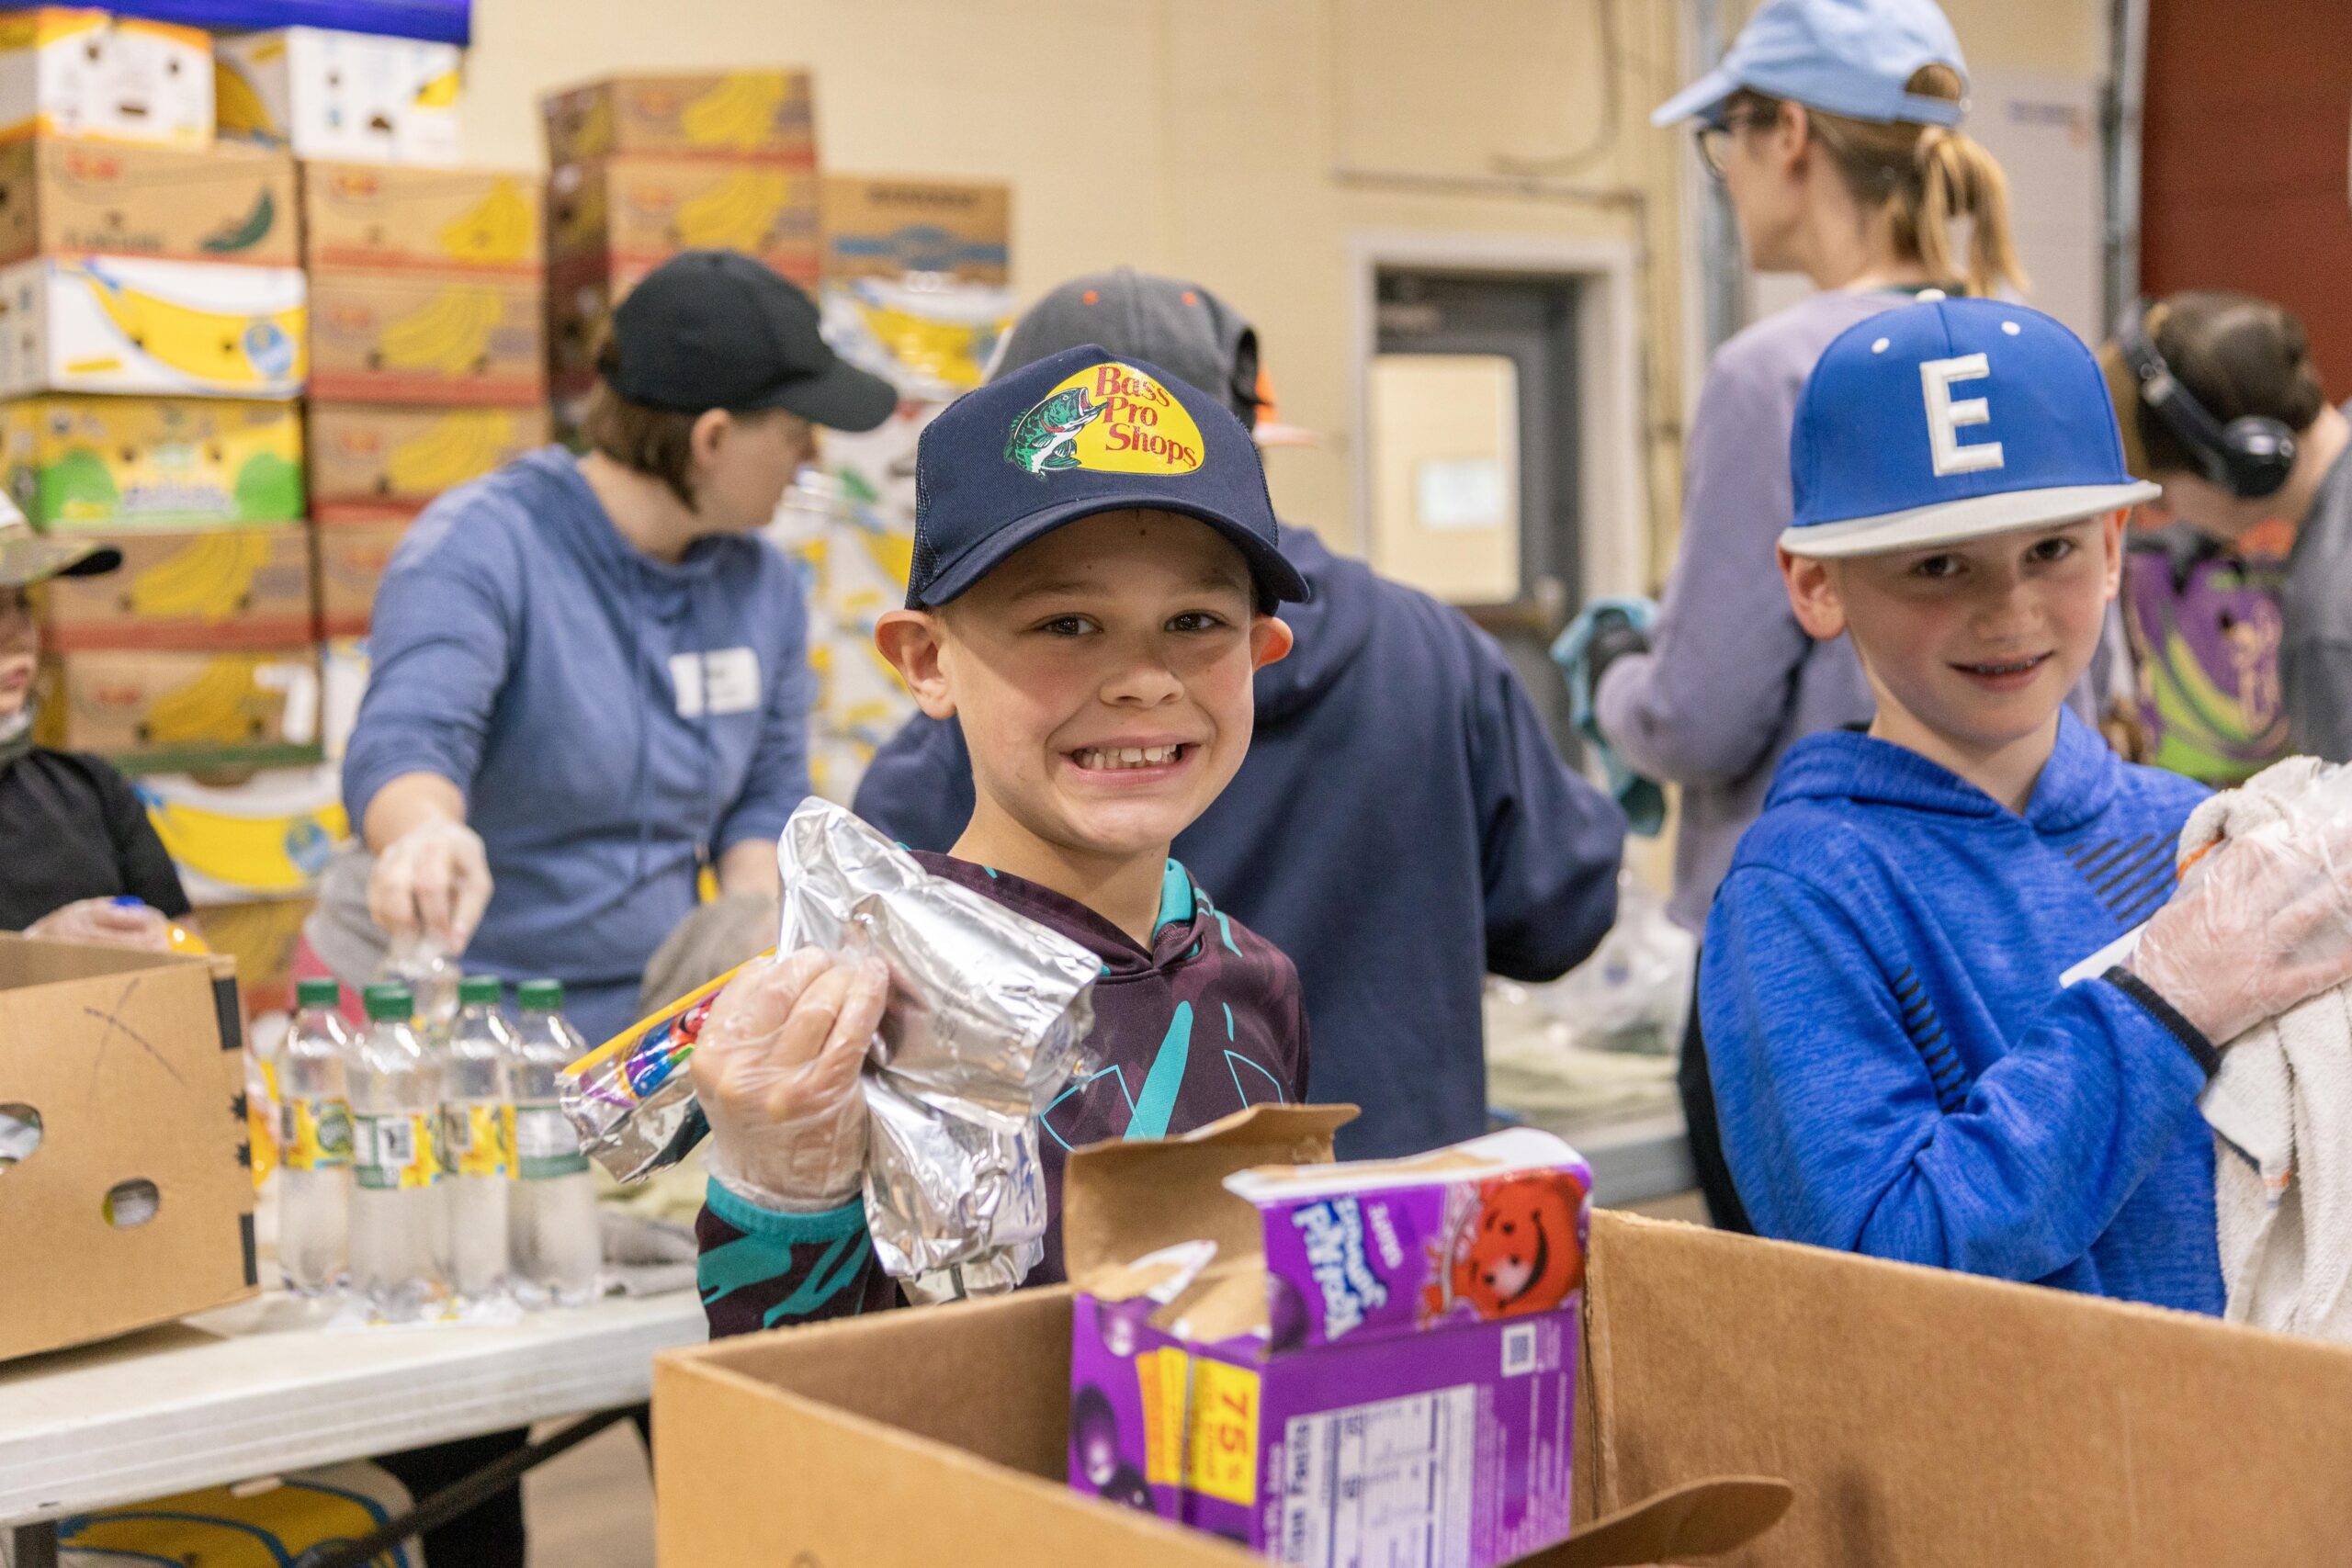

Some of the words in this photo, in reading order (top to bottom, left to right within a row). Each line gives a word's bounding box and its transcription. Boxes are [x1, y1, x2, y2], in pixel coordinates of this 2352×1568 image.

[1095, 366, 1170, 407] Bass
[1102, 396, 1158, 427] Pro
[1919, 352, 2005, 477] E
[1105, 423, 1197, 468] Shops
